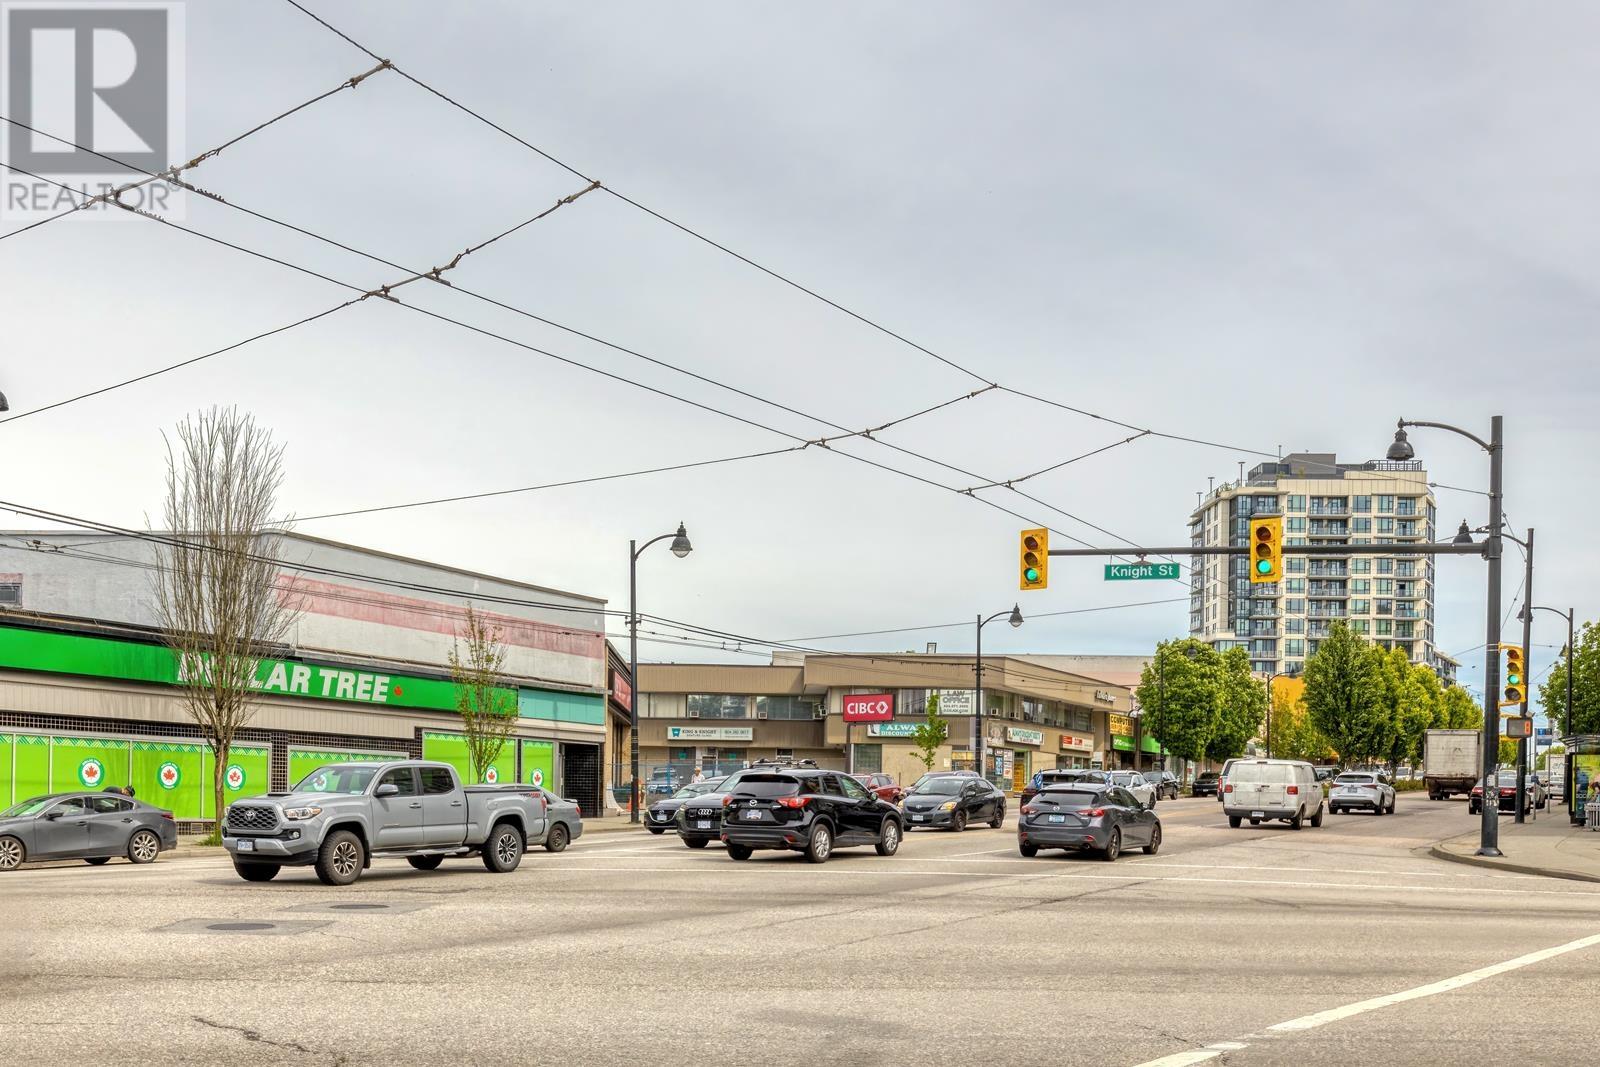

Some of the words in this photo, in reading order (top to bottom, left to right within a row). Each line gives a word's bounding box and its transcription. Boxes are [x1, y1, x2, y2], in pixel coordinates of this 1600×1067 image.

[1111, 565, 1152, 578] Knight
[1158, 565, 1173, 576] St
[319, 668, 390, 702] TREE
[942, 696, 970, 704] OFFICE
[847, 702, 875, 714] CIBC
